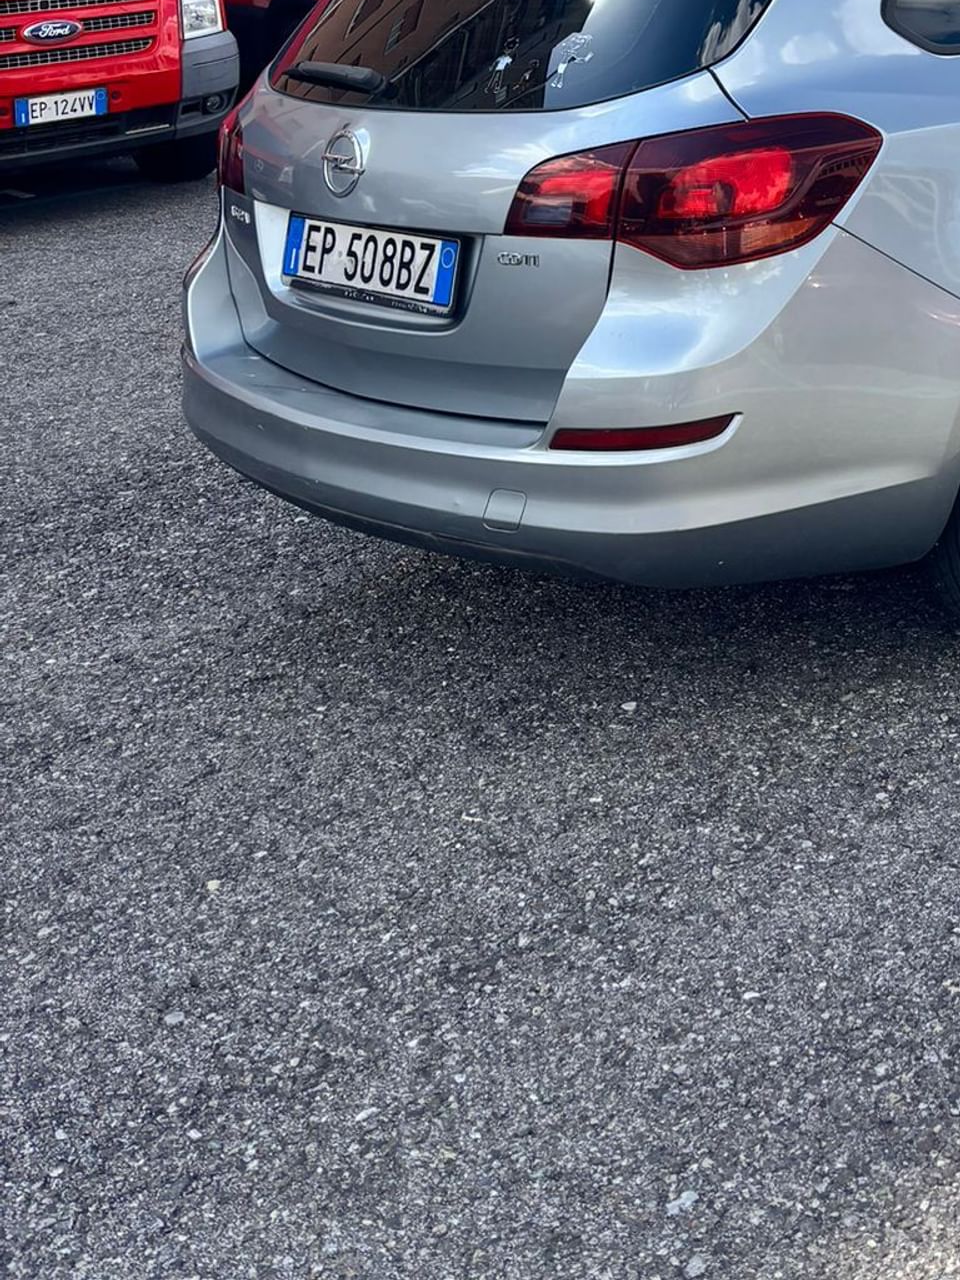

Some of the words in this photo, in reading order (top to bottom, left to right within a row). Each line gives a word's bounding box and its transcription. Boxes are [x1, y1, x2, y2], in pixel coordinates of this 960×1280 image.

[38, 23, 71, 38] Ford
[30, 101, 48, 119] EP
[54, 95, 95, 116] 124VV
[302, 224, 336, 275] EP
[344, 232, 437, 295] 508BZ
